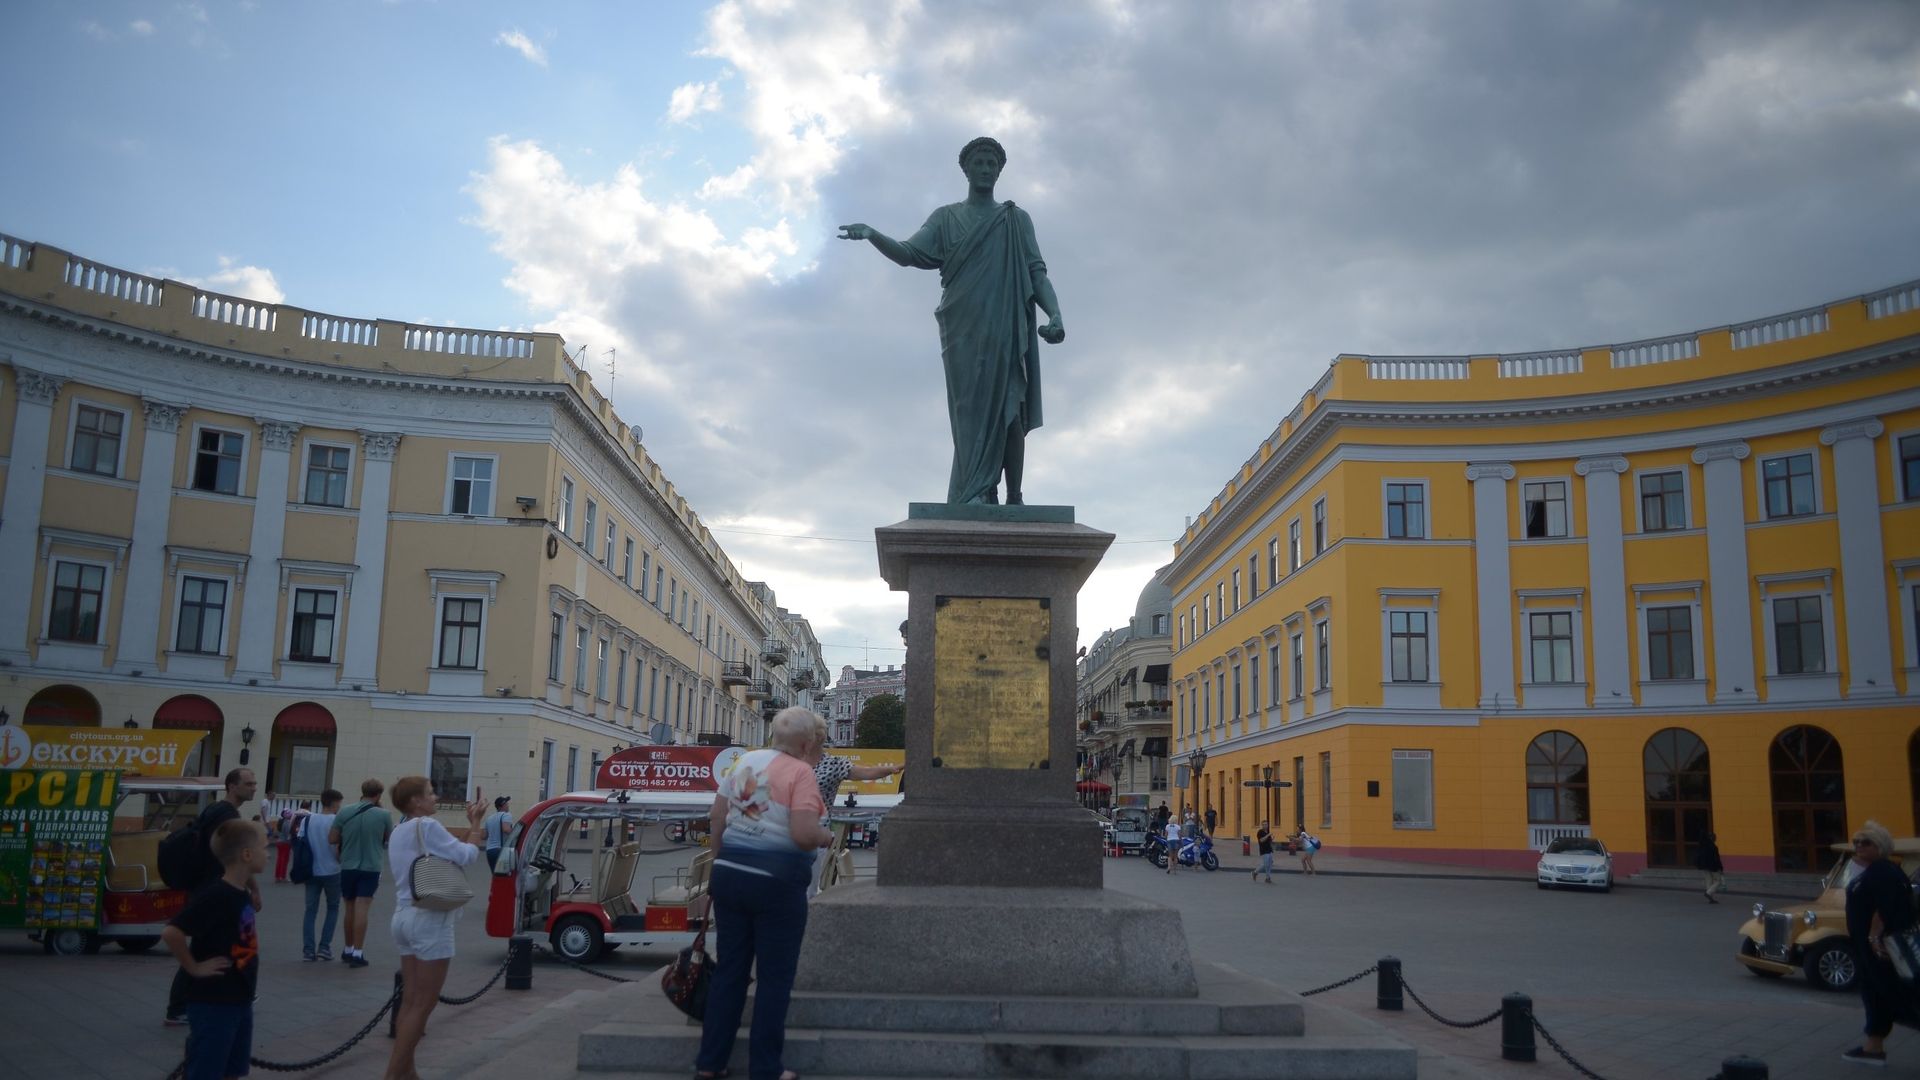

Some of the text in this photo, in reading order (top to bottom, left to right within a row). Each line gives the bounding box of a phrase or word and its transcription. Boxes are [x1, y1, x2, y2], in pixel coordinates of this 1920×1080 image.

[609, 764, 710, 778] CITY TOURS
[629, 778, 649, 787] (095)
[0, 809, 110, 822] SSA CITY TOURS
